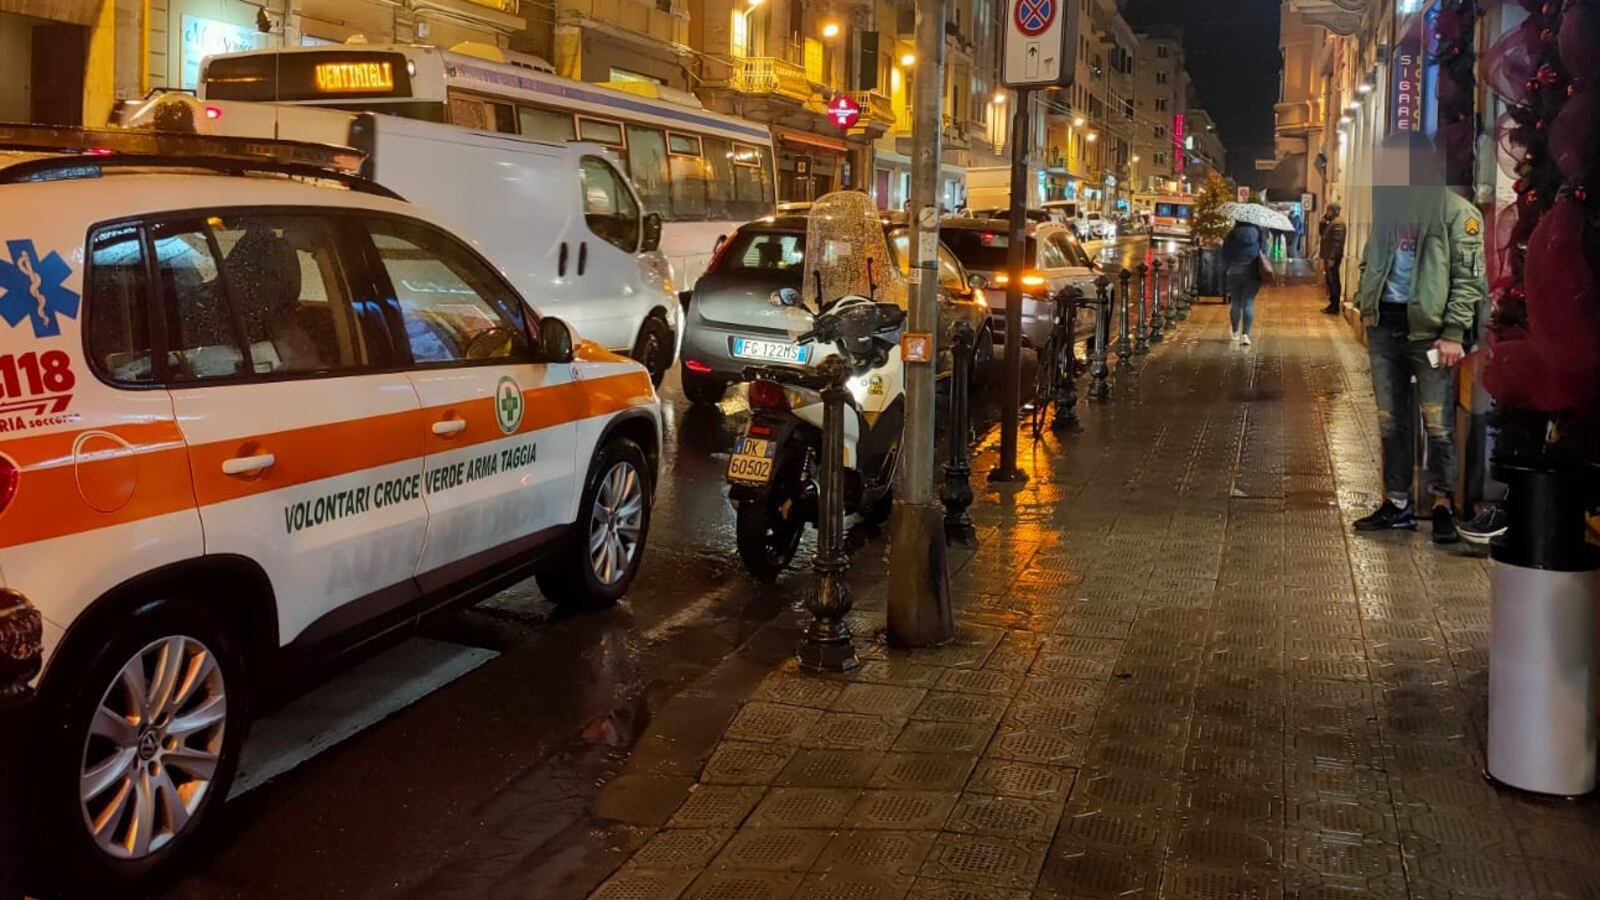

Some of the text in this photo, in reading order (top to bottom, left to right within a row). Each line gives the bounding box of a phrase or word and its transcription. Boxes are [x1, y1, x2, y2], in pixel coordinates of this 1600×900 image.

[744, 440, 760, 457] DK
[731, 458, 770, 477] 60502
[284, 443, 537, 534] VOLONTARI CROCE VERDE ARMA TAGGIA
